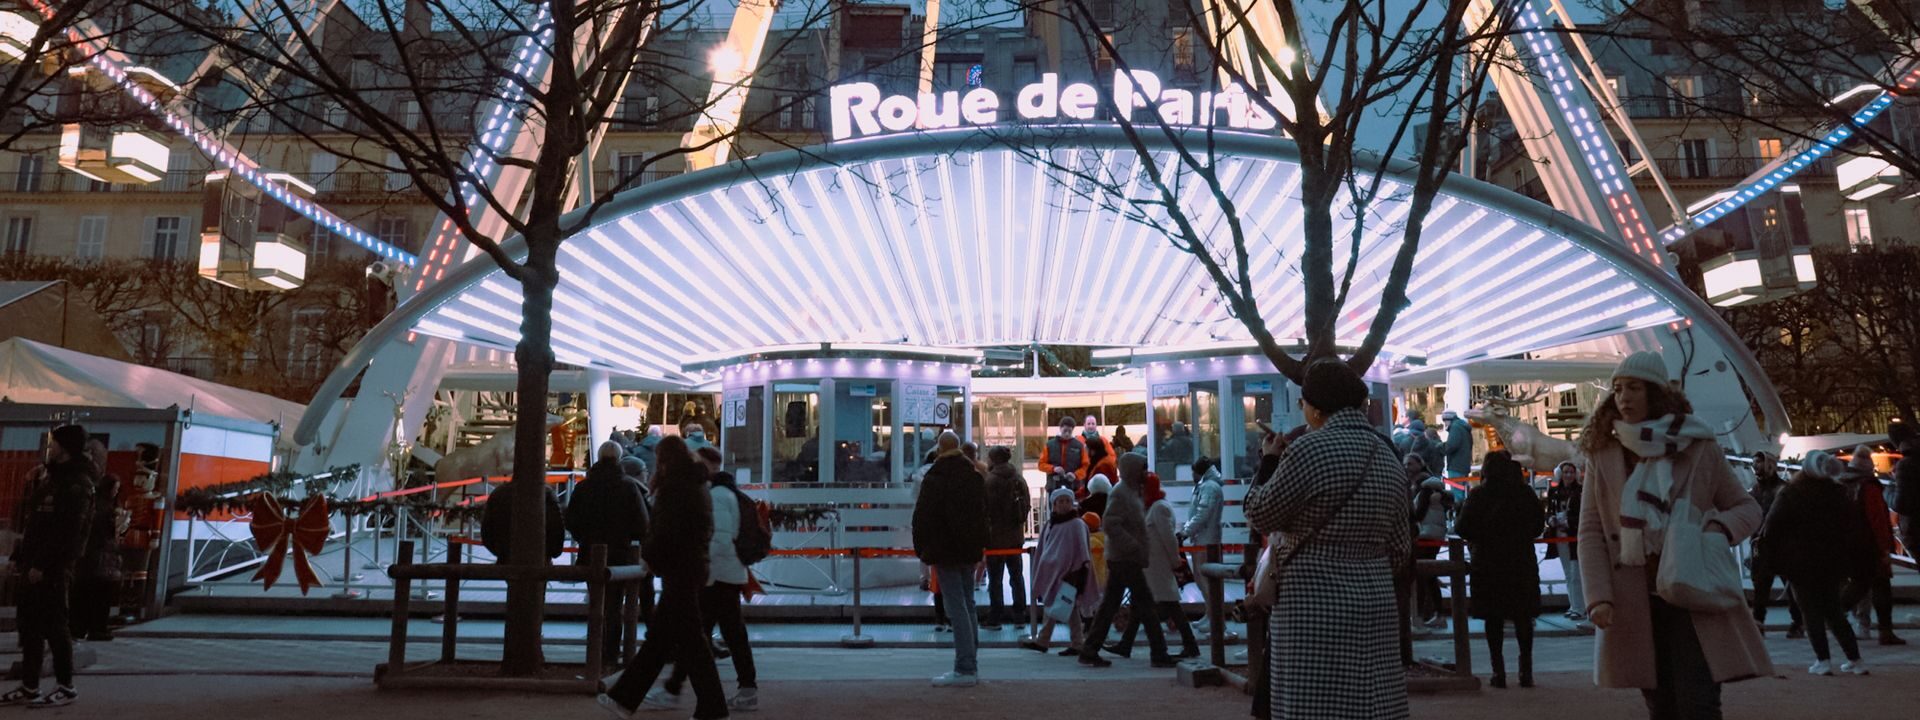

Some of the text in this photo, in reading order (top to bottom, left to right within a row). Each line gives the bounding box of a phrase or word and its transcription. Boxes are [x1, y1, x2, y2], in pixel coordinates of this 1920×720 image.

[830, 69, 1276, 141] Roue de Paris
